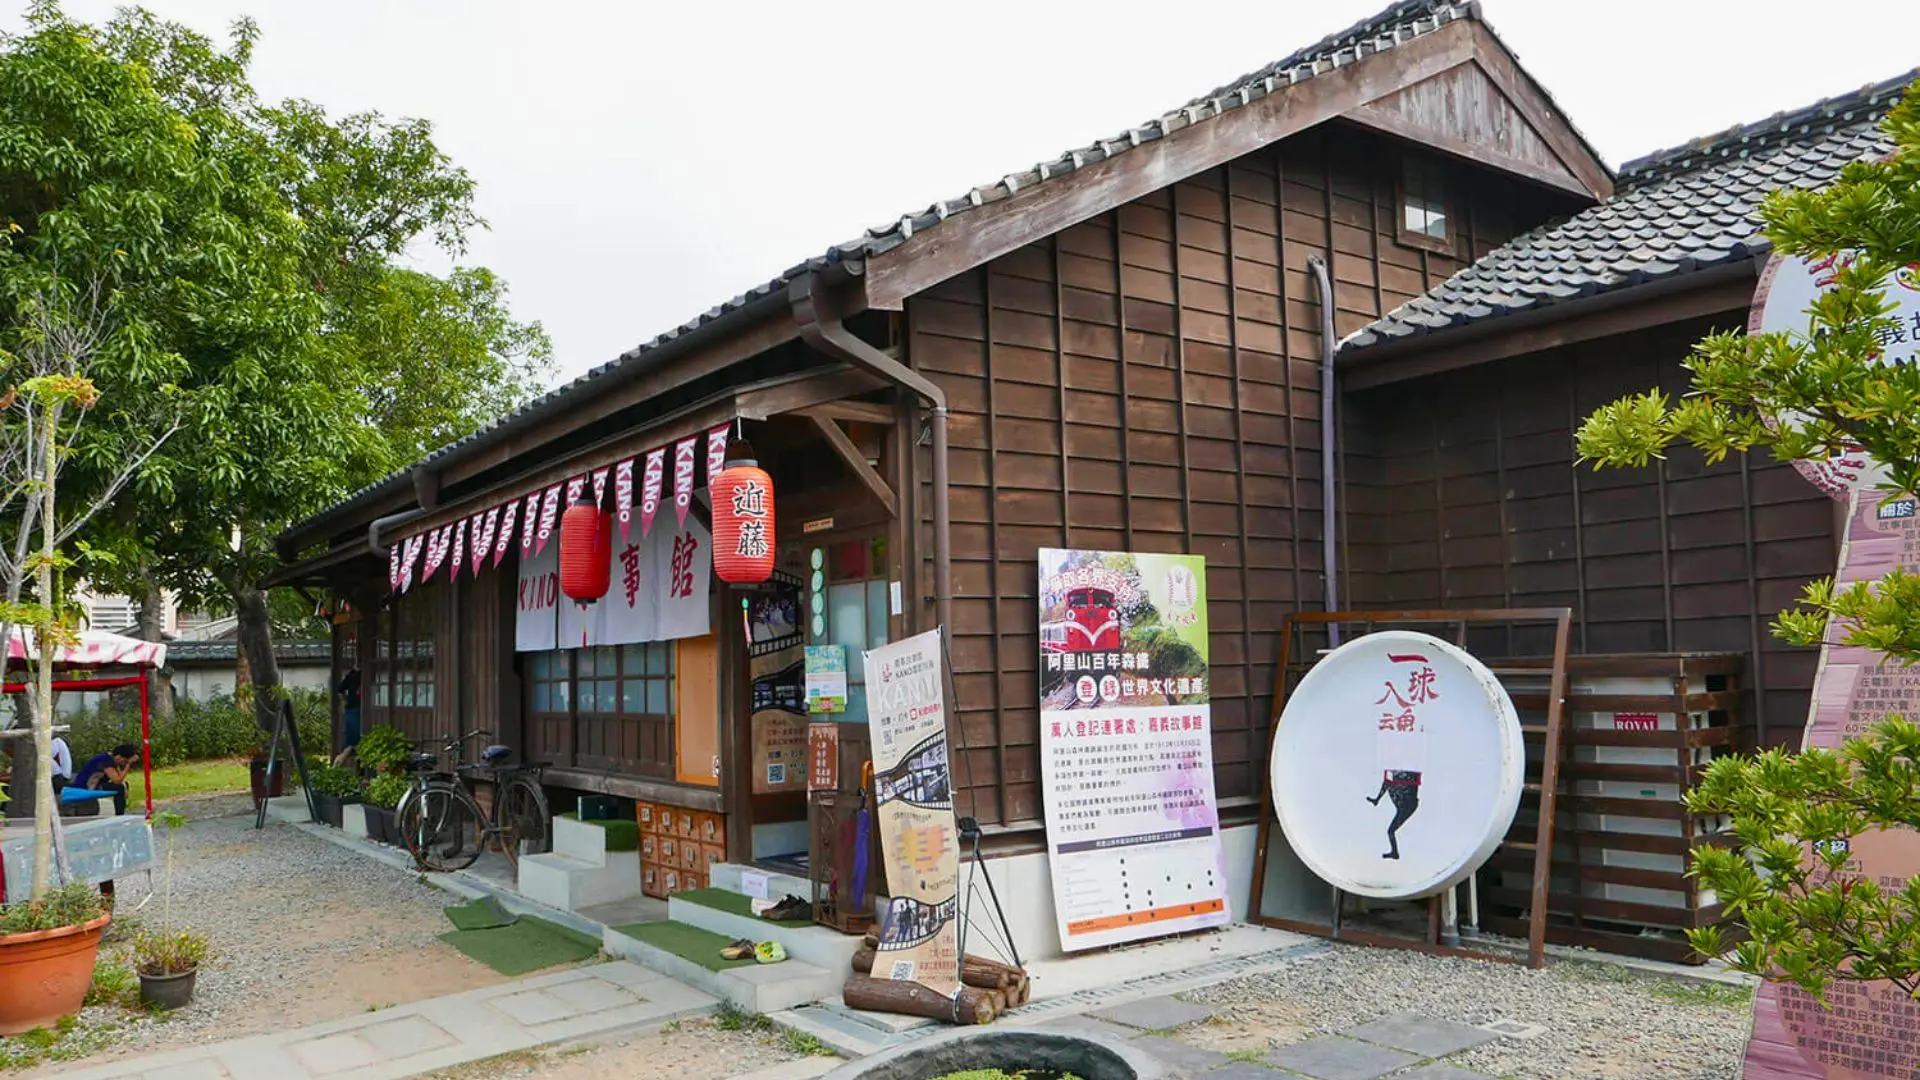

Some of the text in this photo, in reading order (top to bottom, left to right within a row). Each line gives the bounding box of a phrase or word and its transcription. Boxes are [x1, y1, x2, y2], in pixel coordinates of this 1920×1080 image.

[616, 460, 635, 523] KANO
[643, 448, 664, 514] KANO
[676, 438, 697, 506] KANO
[496, 501, 520, 552] KANO
[522, 494, 541, 549] KANO
[536, 485, 561, 540] KANO
[733, 482, 769, 558] 近藤
[1048, 652, 1150, 672] 阿里山百年森鐵
[1079, 676, 1204, 698] 登錄世界文化遺產
[1616, 720, 1656, 731] ROYAL
